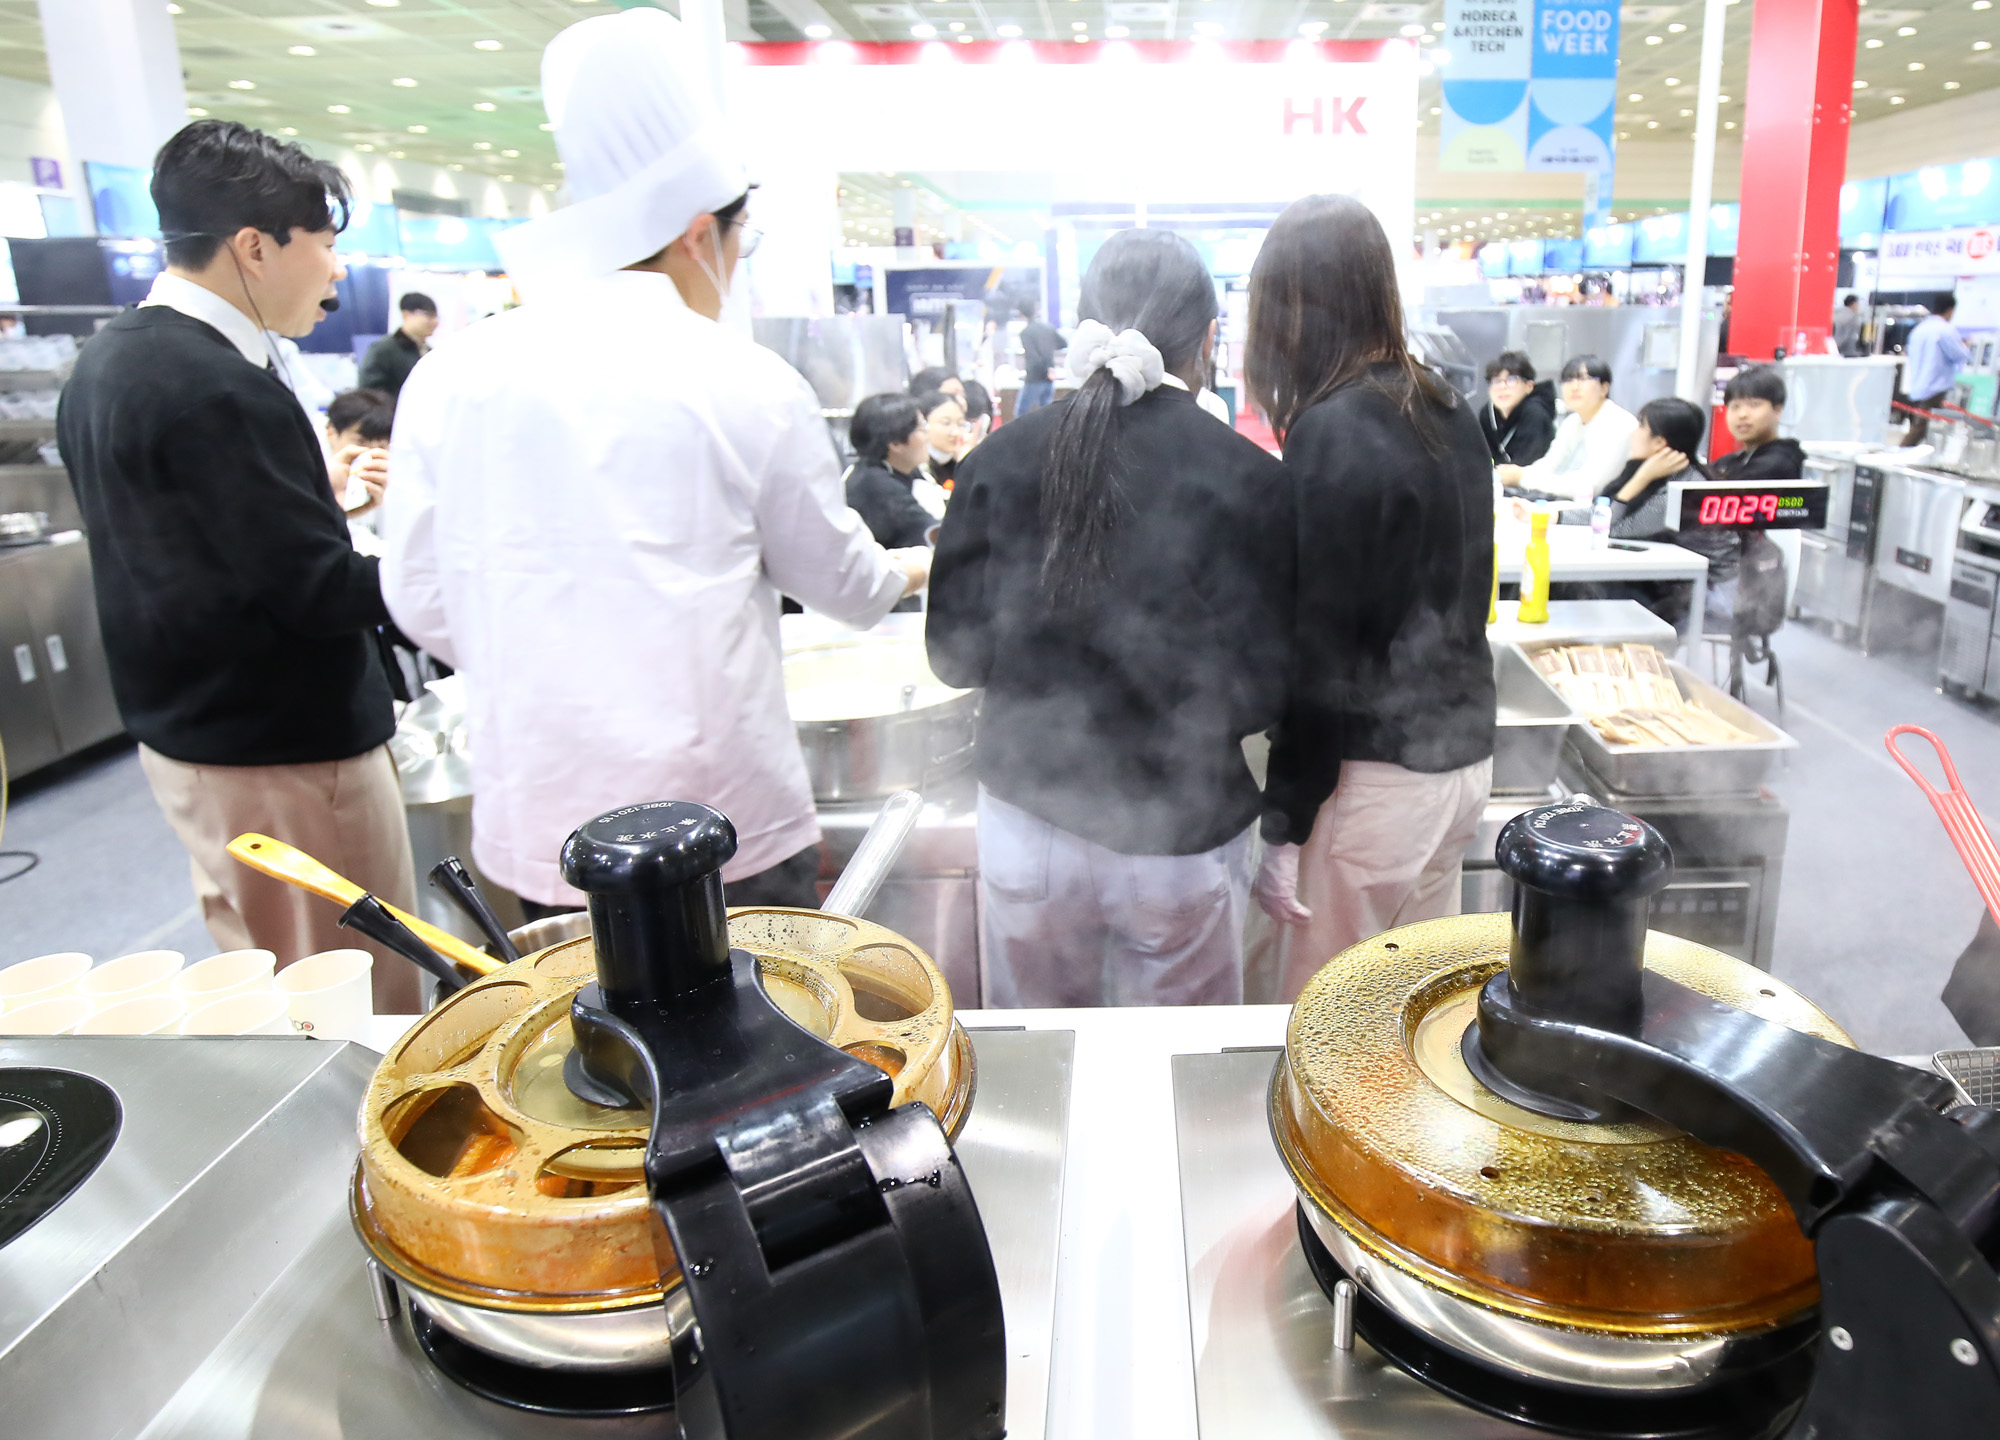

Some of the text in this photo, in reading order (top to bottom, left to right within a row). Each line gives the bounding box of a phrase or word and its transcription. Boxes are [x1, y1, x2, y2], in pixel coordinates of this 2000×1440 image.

[1460, 10, 1518, 22] HORECA
[1541, 10, 1612, 32] FOOD
[1453, 26, 1524, 37] &KITCHEN
[1470, 41, 1506, 53] TECH
[1543, 33, 1609, 55] WEEK
[1283, 97, 1368, 135] HK
[1698, 494, 1779, 525] 0029
